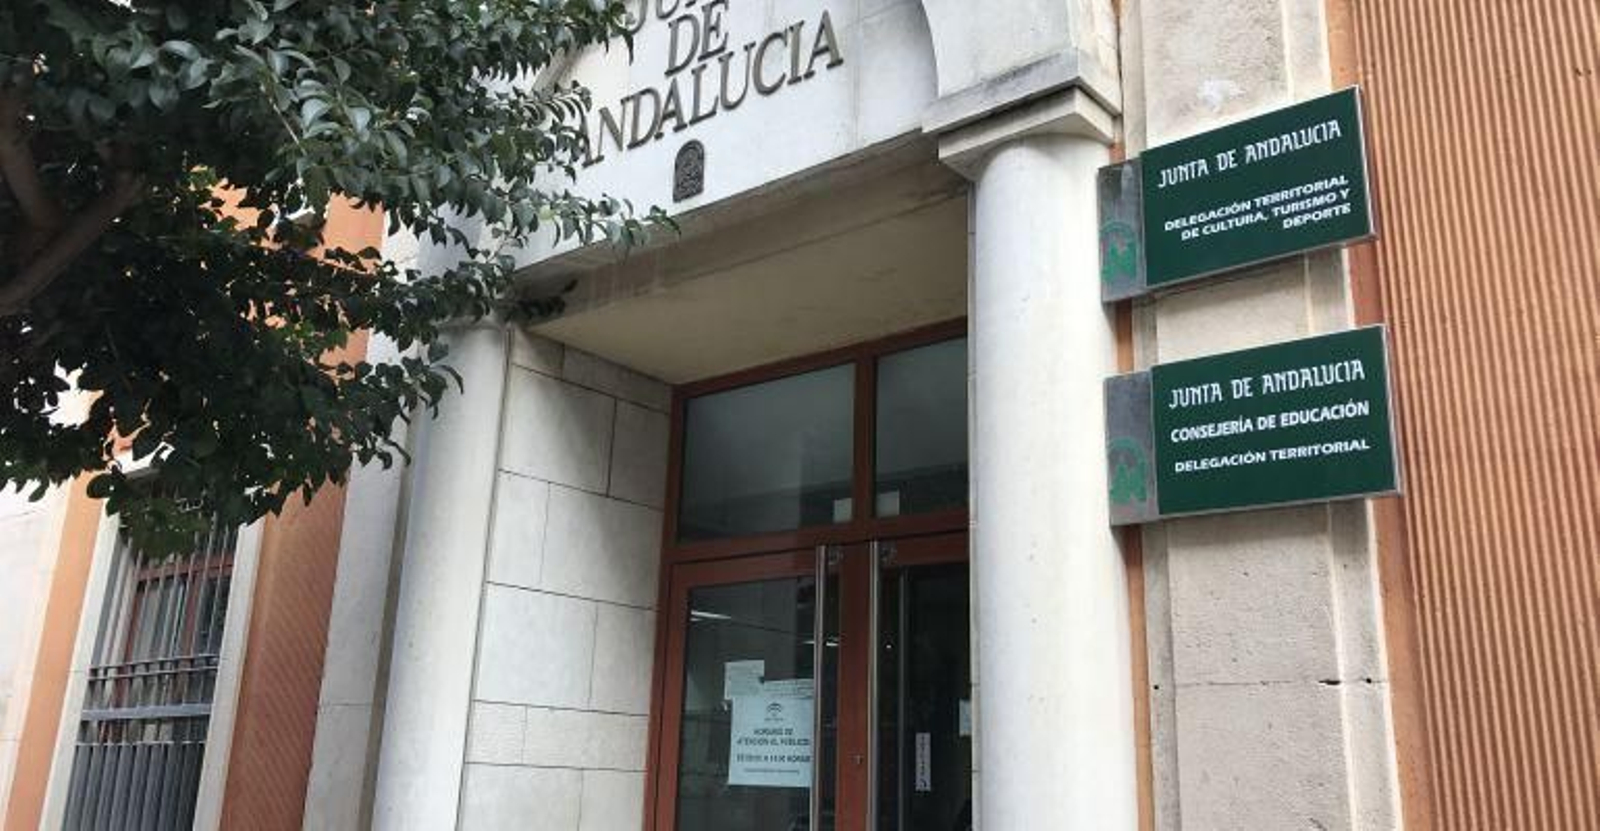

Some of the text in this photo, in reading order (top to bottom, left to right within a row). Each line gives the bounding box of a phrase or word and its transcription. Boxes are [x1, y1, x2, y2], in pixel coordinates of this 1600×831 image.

[664, 0, 729, 76] DE
[1158, 119, 1342, 188] JUNTA DE ANDALUCIA
[1164, 175, 1349, 232] DELEGACIÓN TERRITORIAL
[1181, 188, 1351, 241] DE CULTURA, TURISMO Y
[1283, 203, 1351, 229] DEPORTE
[1169, 358, 1366, 409] JUNTA DE ANDALUCIA
[1171, 398, 1369, 443] CONSEJERÍA DE EDUCACIÓN
[1175, 439, 1371, 473] DELEGACIÓN TERRITORIAL
